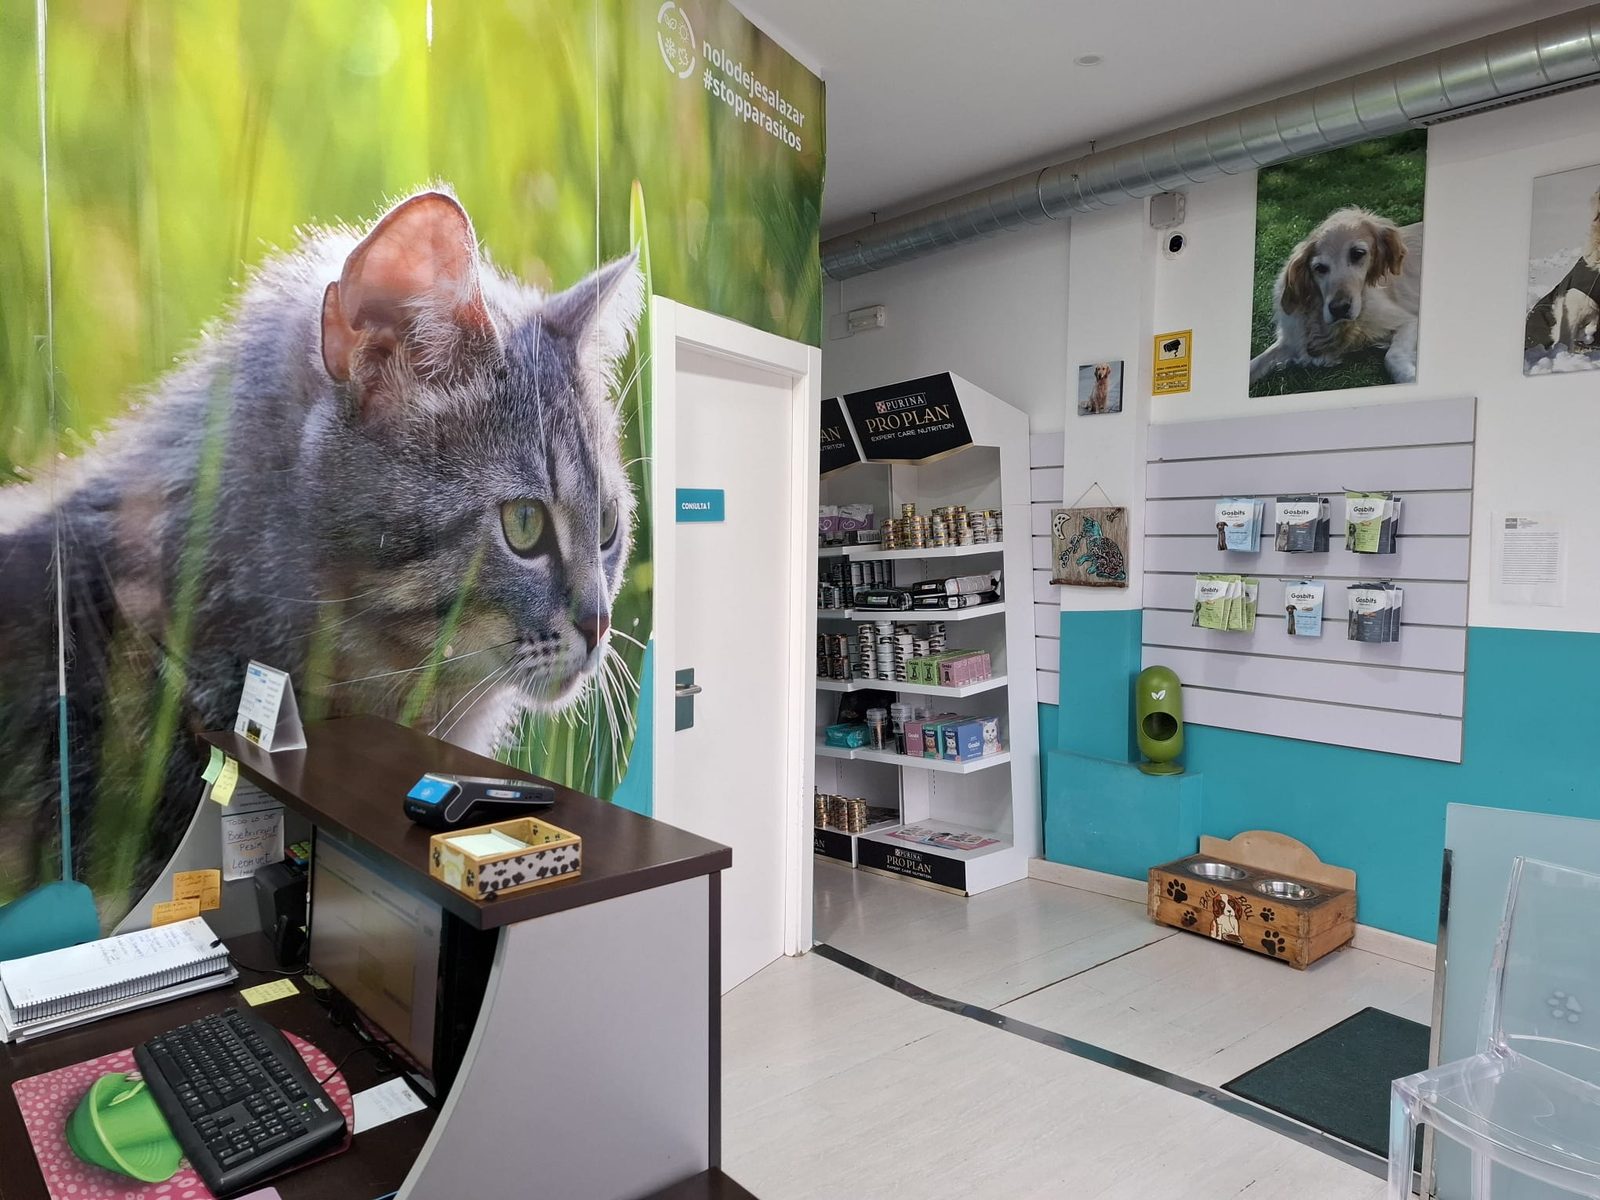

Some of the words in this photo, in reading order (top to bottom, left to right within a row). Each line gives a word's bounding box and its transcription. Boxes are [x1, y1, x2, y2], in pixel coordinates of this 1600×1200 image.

[702, 39, 805, 128] nolodejesalazar
[703, 68, 802, 152] #stopparasitos
[885, 395, 925, 410] PURINA
[866, 414, 900, 434] PRO
[901, 404, 950, 427] PLAN
[871, 432, 896, 441] EXPERT
[897, 429, 916, 438] CARE
[917, 422, 955, 434] NUTRITION
[681, 502, 707, 510] CONSULTA
[886, 854, 906, 867] PRO
[906, 859, 932, 874] PLAN
[1199, 887, 1217, 910] BAU
[1235, 895, 1255, 920] BAU
